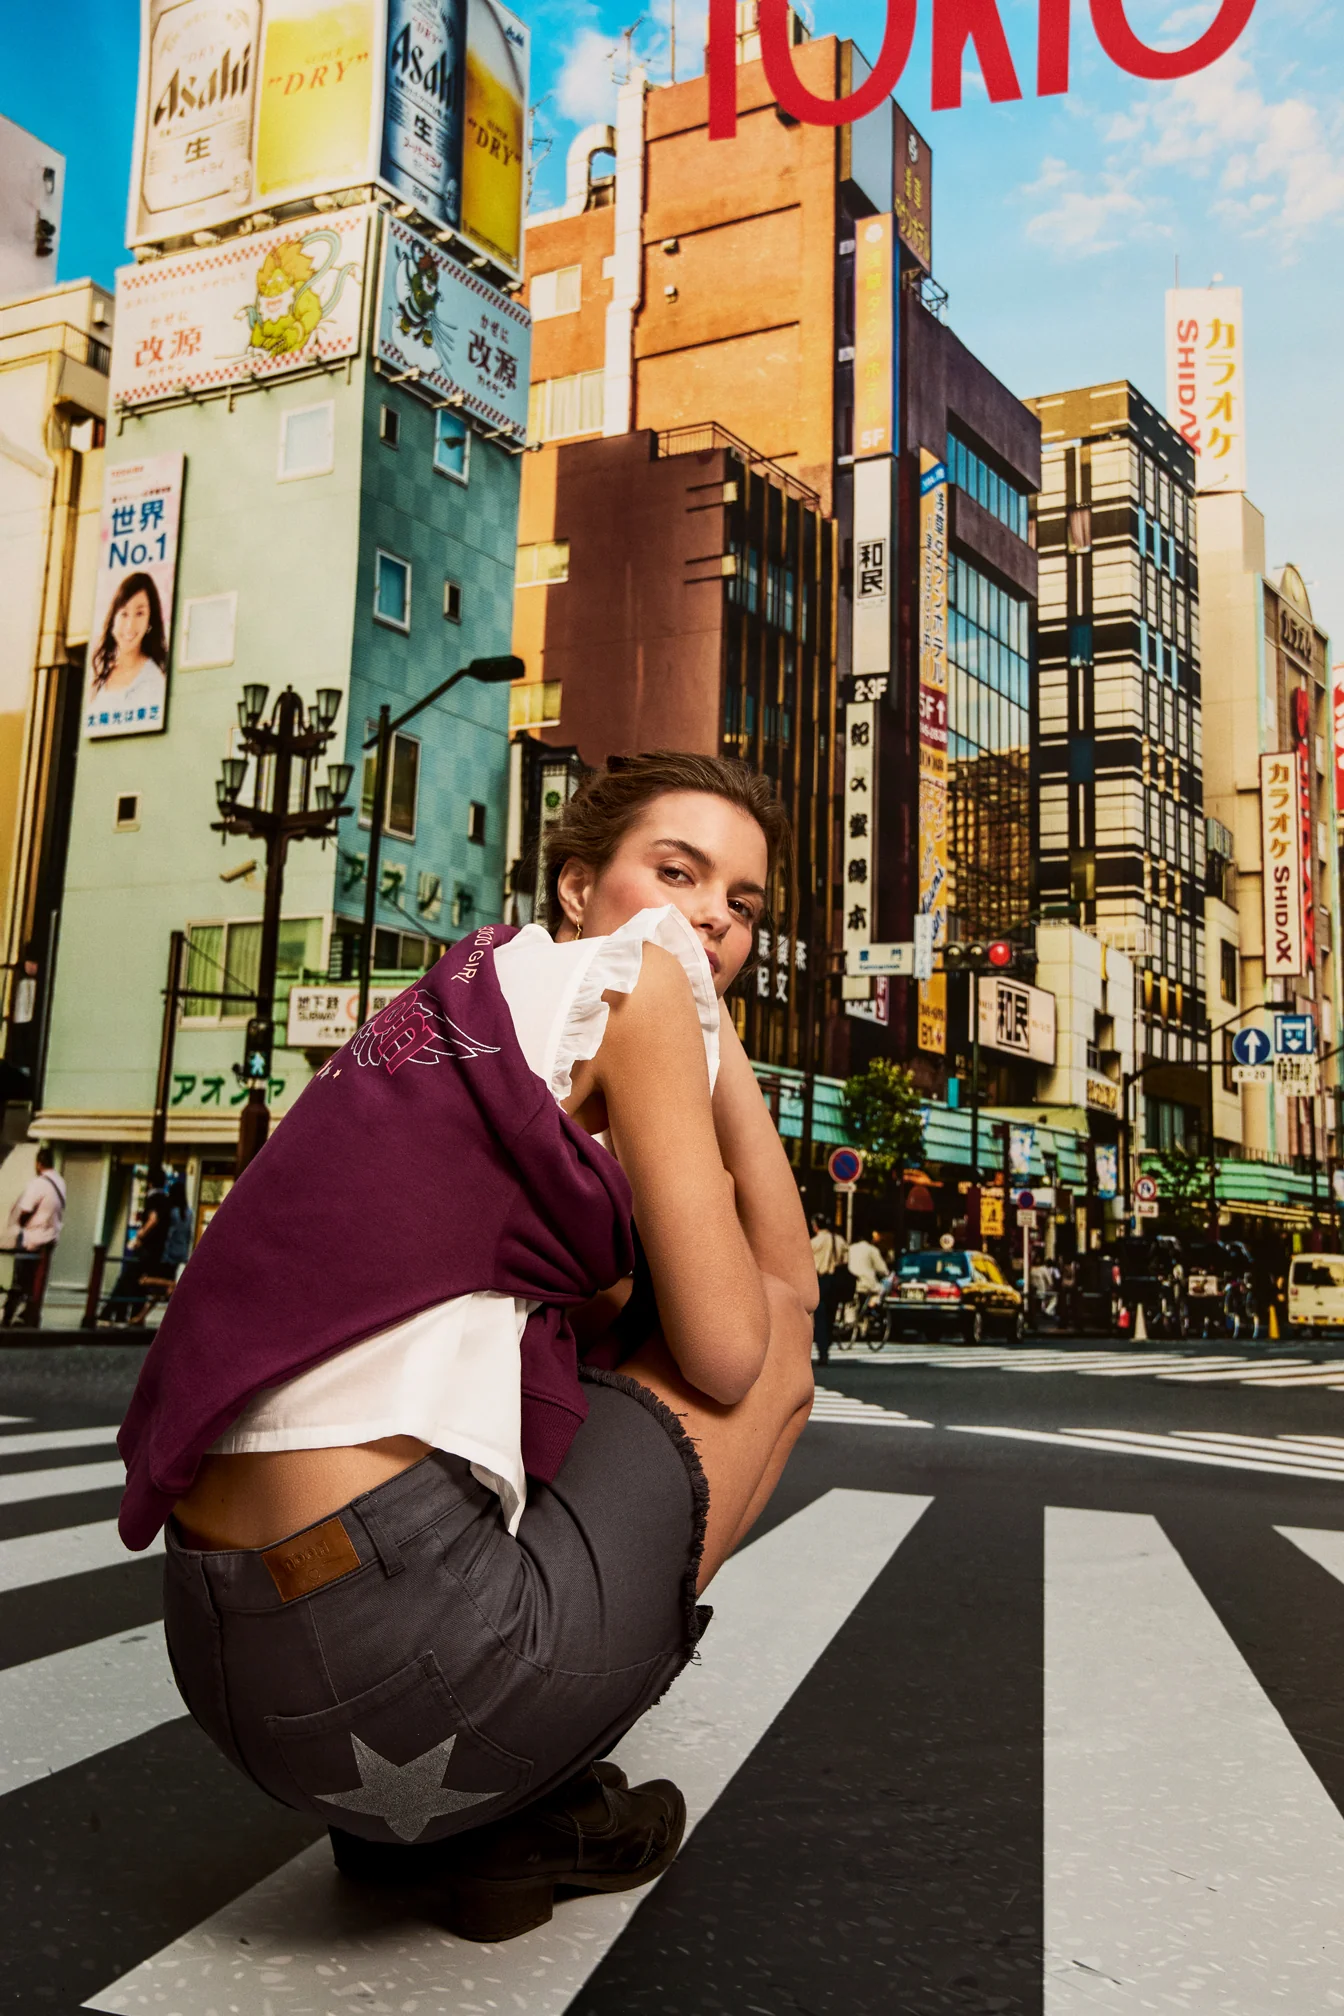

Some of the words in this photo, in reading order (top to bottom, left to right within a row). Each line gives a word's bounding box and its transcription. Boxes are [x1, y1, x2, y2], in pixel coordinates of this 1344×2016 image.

[153, 41, 251, 127] Asahi
[184, 136, 211, 164] 生
[414, 114, 433, 147] 生
[468, 330, 519, 391] 改源
[1204, 317, 1239, 459] カラオケ
[112, 500, 165, 537] 世界
[109, 533, 166, 570] No.1
[861, 543, 883, 595] 和民
[1268, 763, 1292, 861] カラオケ
[1273, 866, 1293, 964] SHIDAX
[451, 950, 485, 984] GIRL
